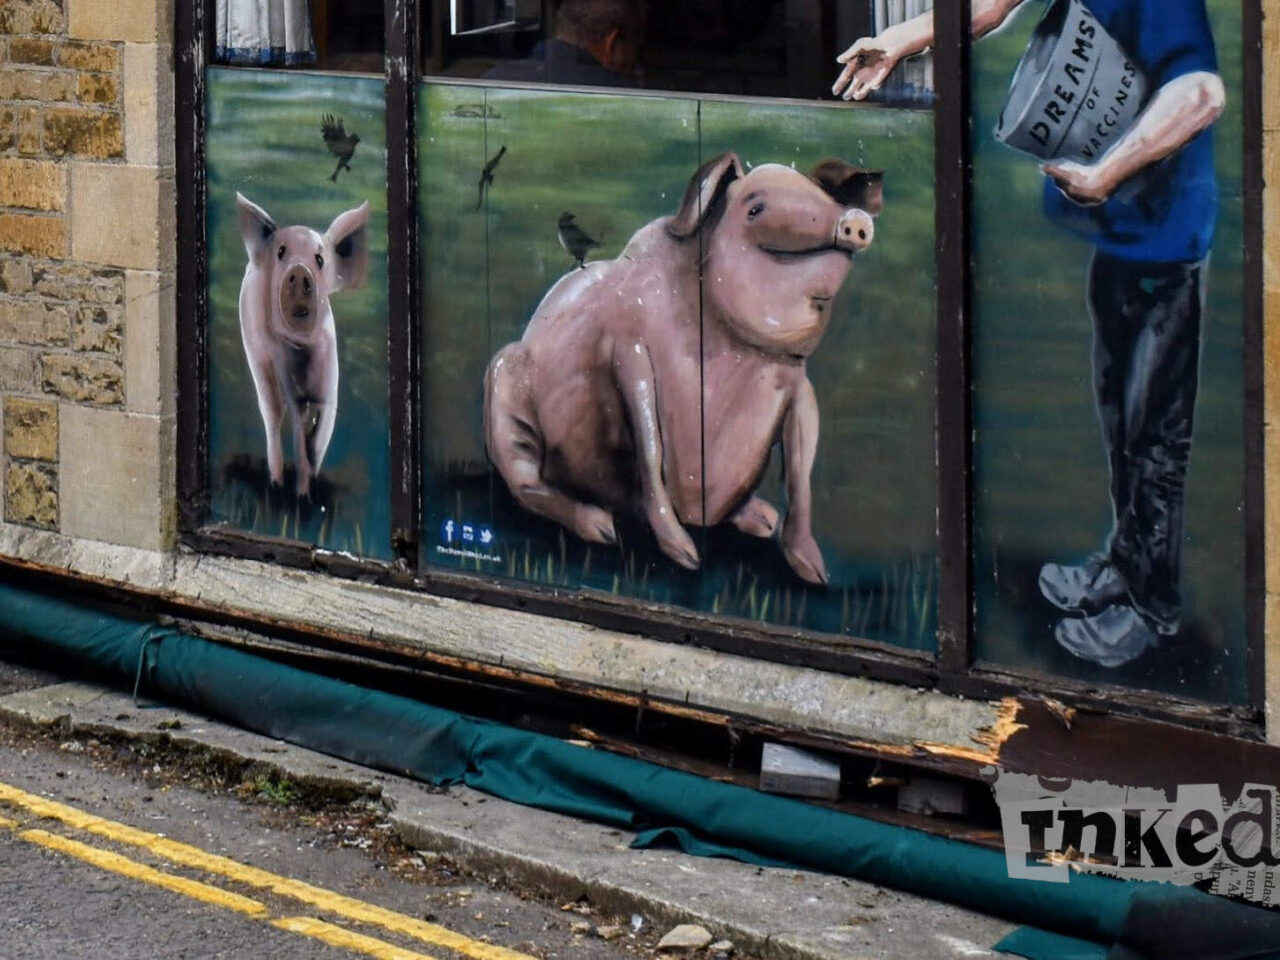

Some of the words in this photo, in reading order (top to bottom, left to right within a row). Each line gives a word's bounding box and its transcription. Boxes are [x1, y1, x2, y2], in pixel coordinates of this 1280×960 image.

[1029, 20, 1096, 147] DREAMS
[1082, 62, 1136, 158] VACCINES
[1086, 87, 1101, 110] OF
